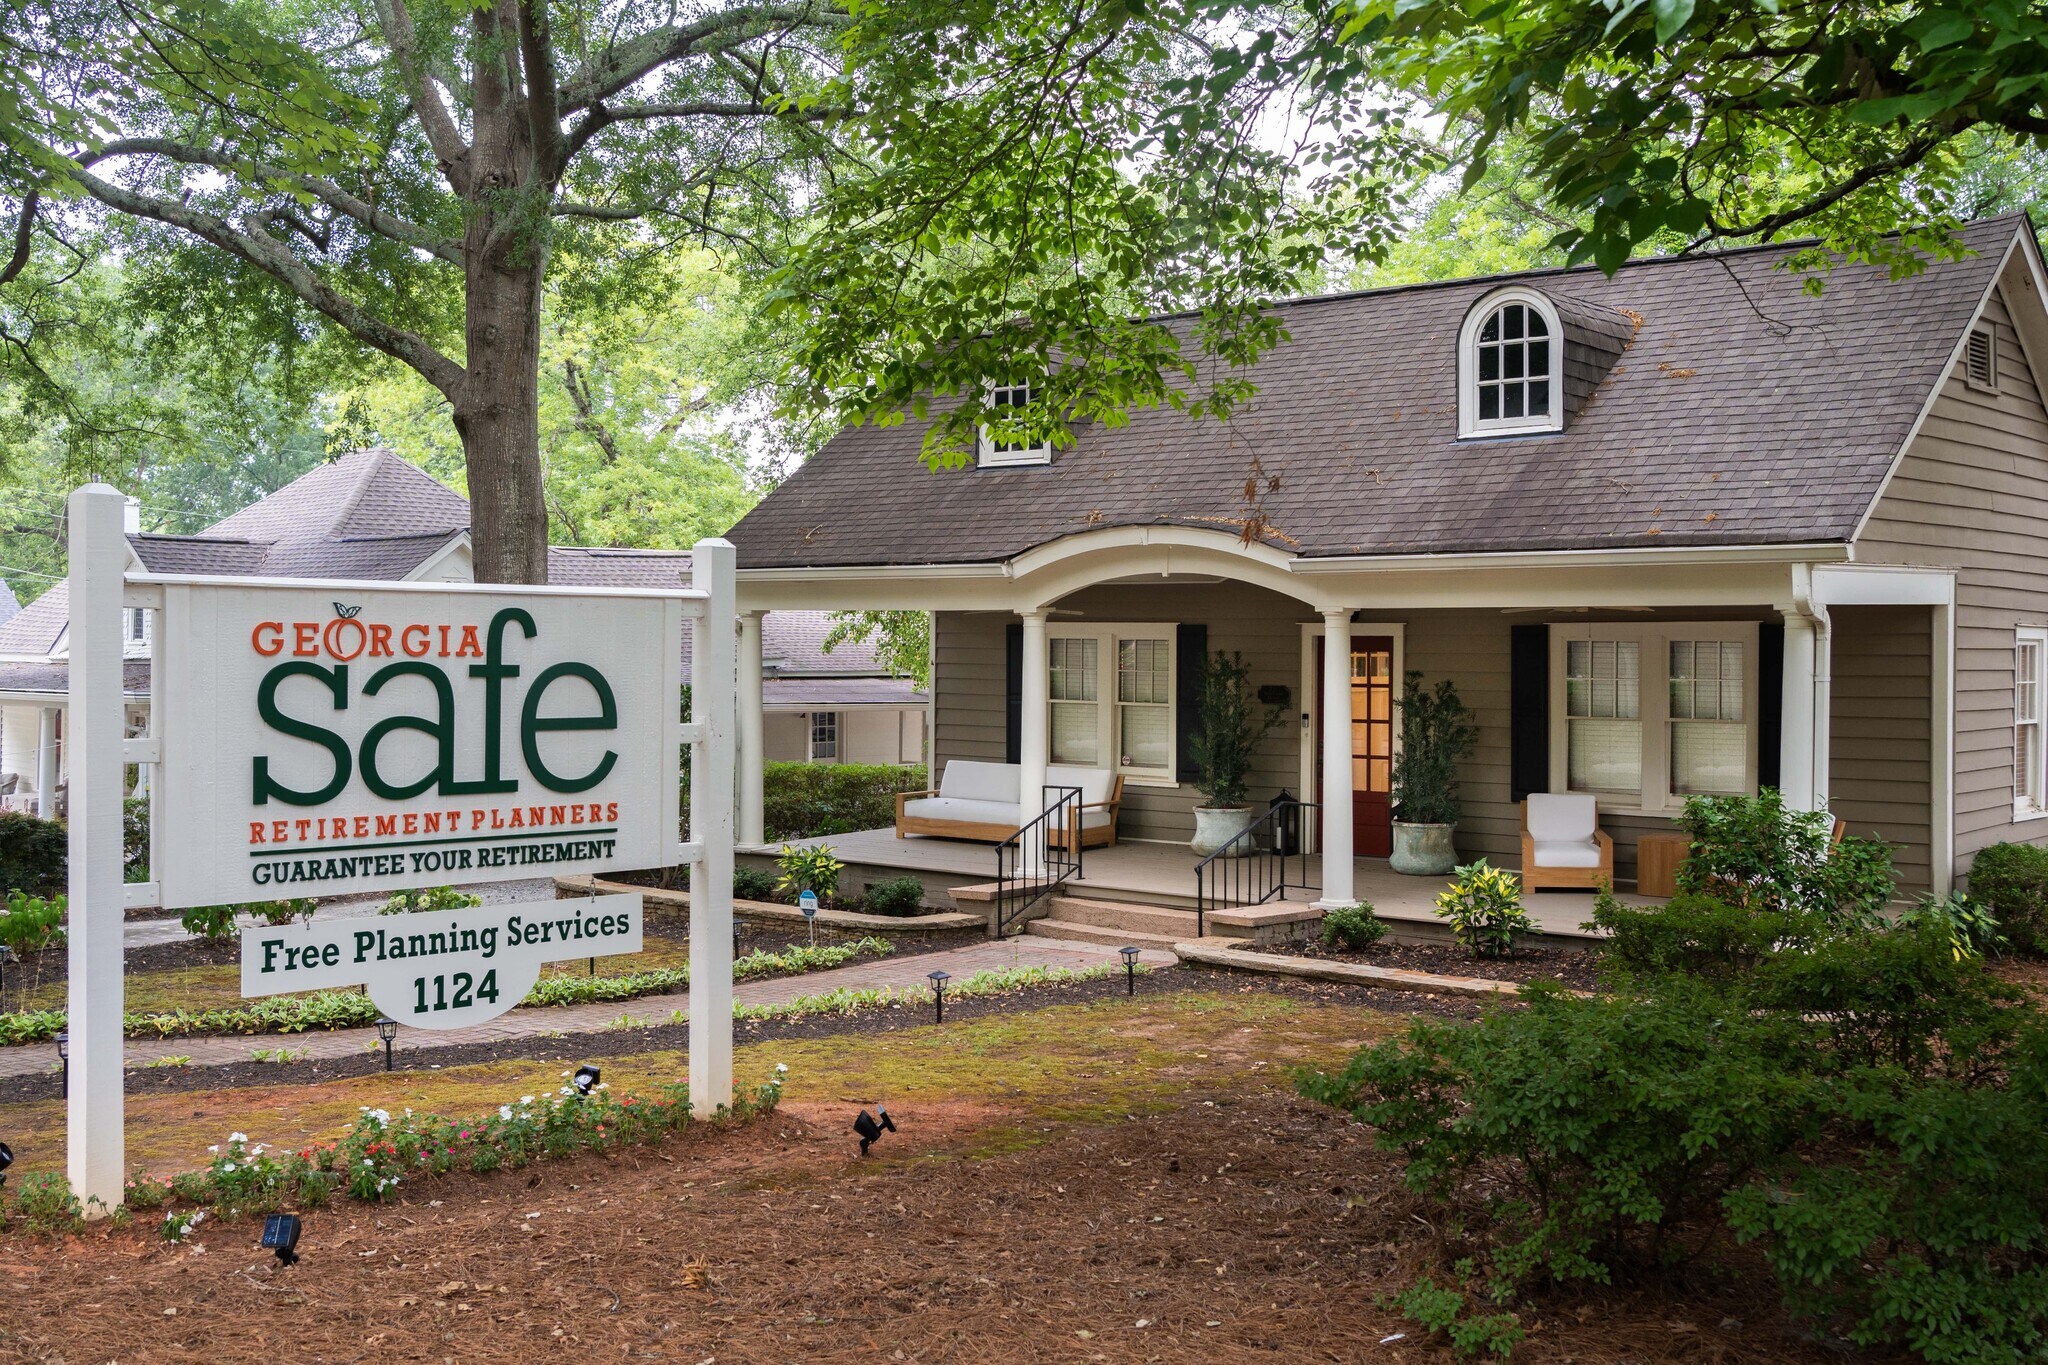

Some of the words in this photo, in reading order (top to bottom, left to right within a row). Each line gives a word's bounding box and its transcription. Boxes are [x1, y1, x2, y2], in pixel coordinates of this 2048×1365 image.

[251, 617, 484, 662] GEORGIA
[252, 607, 618, 807] safe
[249, 810, 462, 844] RETIREMENT
[471, 802, 619, 831] PLANNERS
[252, 852, 406, 886] GUARANTEE
[409, 848, 474, 874] YOUR
[477, 839, 616, 869] RETIREMENT
[260, 938, 340, 974] Free
[353, 921, 500, 965] Planning
[507, 909, 630, 947] Services
[413, 968, 500, 1014] 1124
